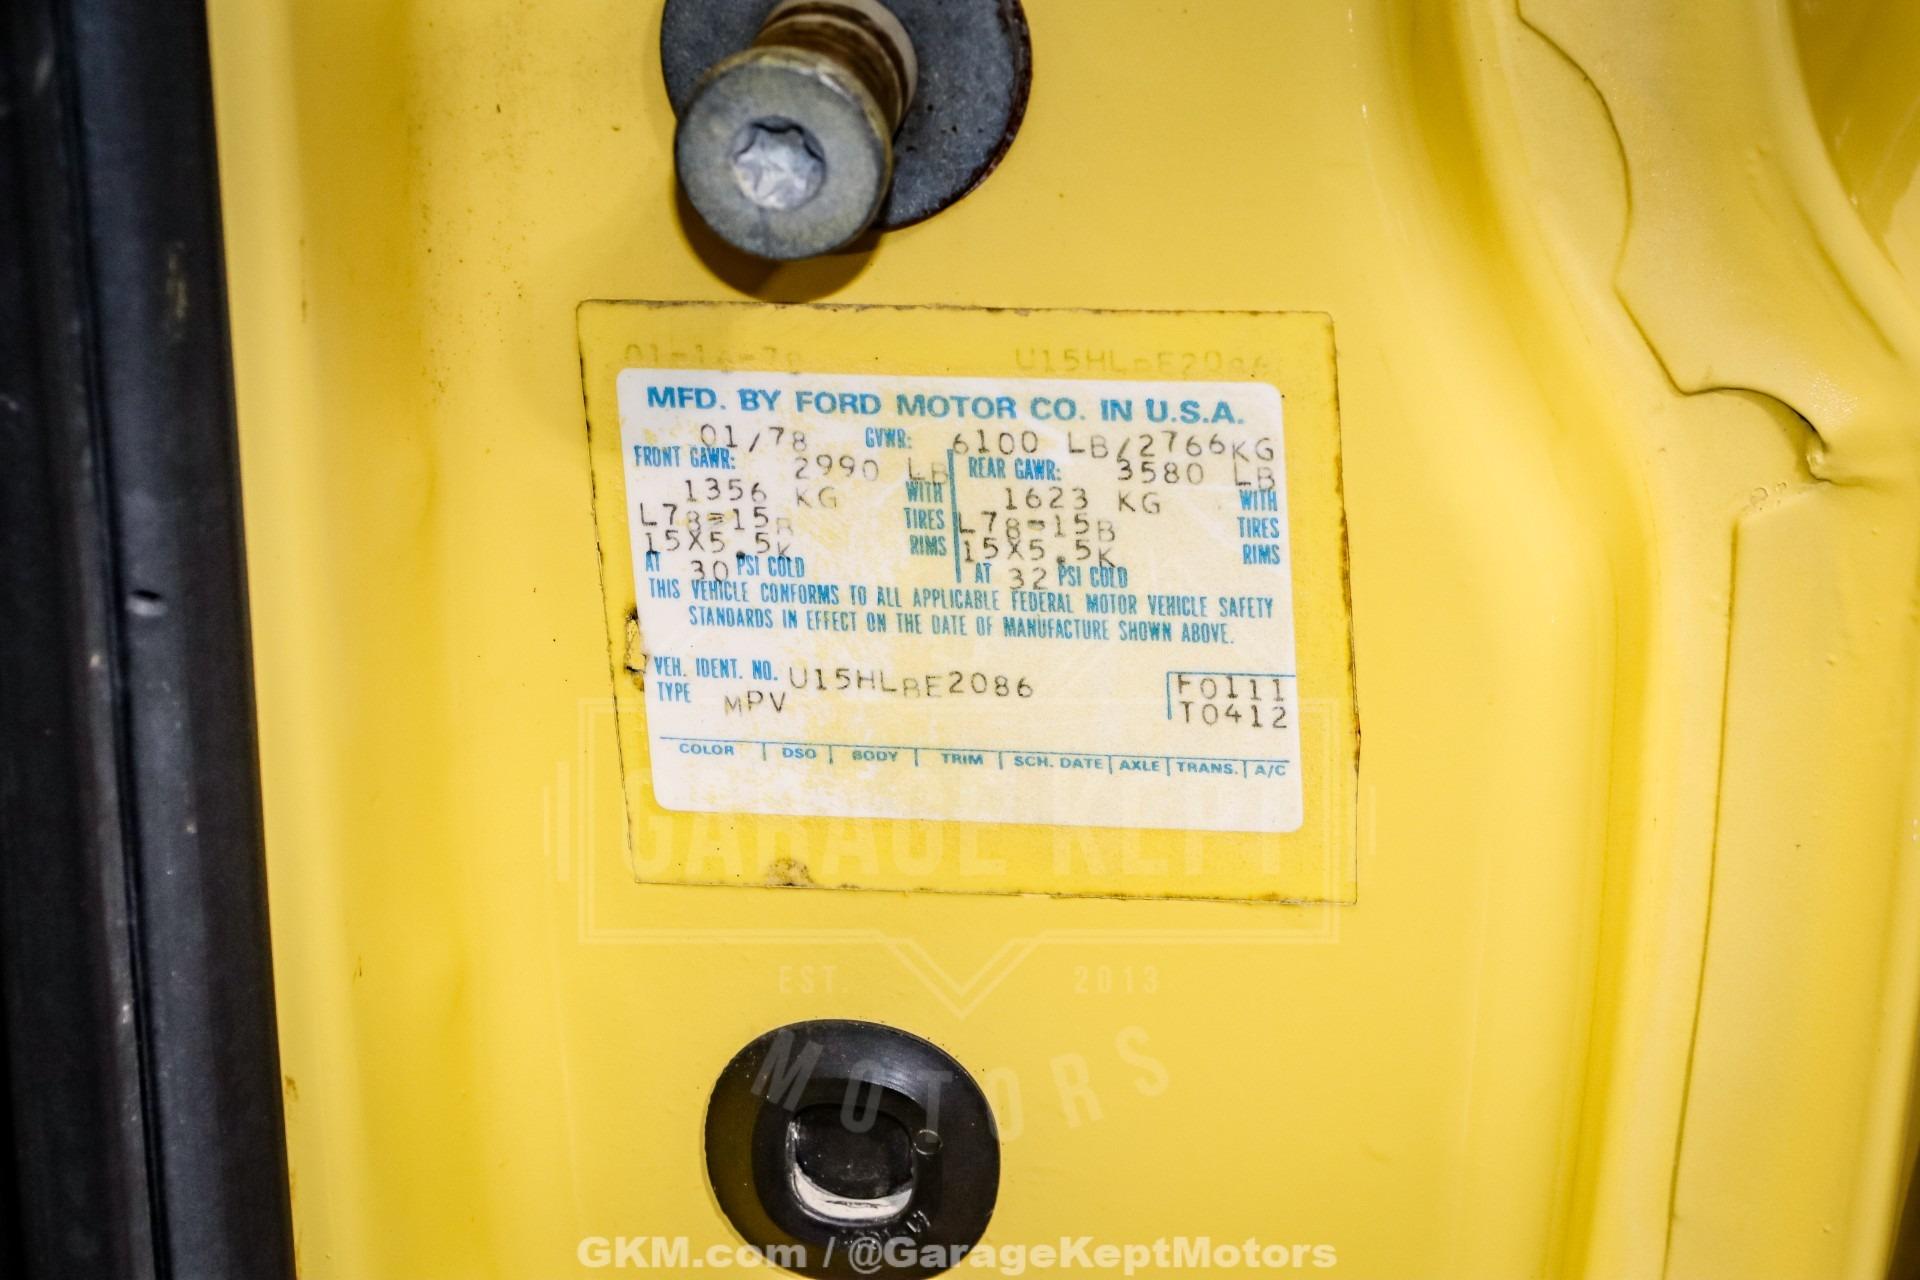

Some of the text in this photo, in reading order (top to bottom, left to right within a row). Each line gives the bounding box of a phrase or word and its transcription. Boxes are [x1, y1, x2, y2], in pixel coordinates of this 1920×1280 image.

[647, 387, 1245, 424] MFD. BY FORD MOTOR CO. IN U.S.A.
[700, 423, 807, 452] 01/78
[865, 428, 911, 449] GVWR:
[952, 429, 1038, 454] 6100
[634, 445, 948, 484] FRONT GAWR: 2990 LB
[968, 457, 1276, 490] REAR GAWR: 3580 LB
[686, 478, 943, 509] 1356 KG WITH
[1005, 487, 1278, 515] 1623 KG WITH
[903, 507, 945, 530] TIRES
[1238, 517, 1279, 539] TIRES
[910, 536, 947, 556] RIMS
[1243, 544, 1280, 565] RIMS
[645, 552, 804, 582] AT 30 PSI COLD
[975, 563, 1129, 590] AT 32 PSI COLD
[649, 578, 1274, 619] THIS VEHICLE CONFORMS TO ALL APPLICABLE FEDERAL MOTOR VEHICLE SAFETY
[688, 605, 1234, 645] STANDARDS IN EFFECT ON THE DATE OF MANUFACTURE SHOWN ABOVE.
[654, 656, 687, 678] VEH.
[695, 657, 743, 680] IDENT.
[752, 660, 778, 681] NO.
[657, 682, 787, 716] TYPE MPV
[679, 743, 1287, 777] COLOR DSO BODY TRIM SCH. DATE AXLE TRANS. A/C
